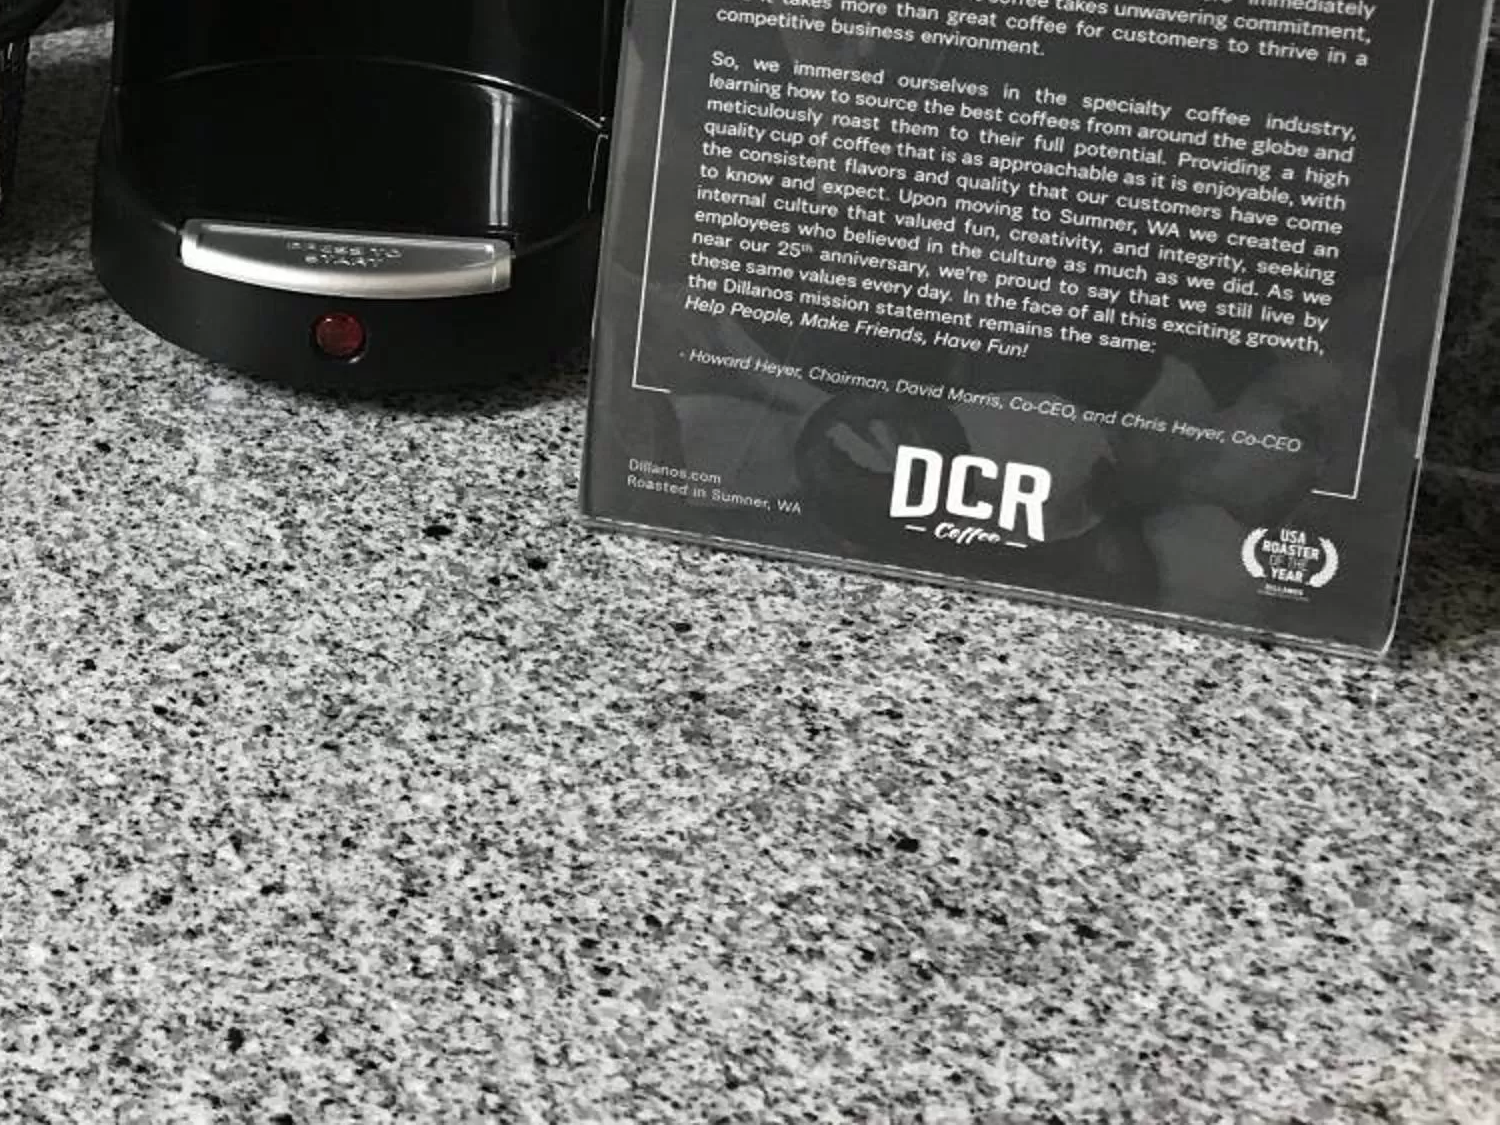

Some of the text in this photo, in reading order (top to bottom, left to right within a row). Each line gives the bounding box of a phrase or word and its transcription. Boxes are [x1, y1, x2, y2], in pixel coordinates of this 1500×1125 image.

[715, 7, 1045, 56] competitive business environment.
[895, 1, 939, 21] than
[945, 9, 997, 28] great
[1004, 13, 1068, 35] coffee
[1074, 18, 1105, 38] for
[1110, 27, 1219, 51] customers
[1226, 36, 1250, 54] to
[1257, 39, 1319, 61] thrive
[1326, 45, 1347, 64] in
[1353, 52, 1369, 67] a
[1112, 3, 1229, 31] unwavering
[1232, 15, 1371, 45] commitment,
[710, 49, 1357, 142] So, we immersed ourselves in the specialty coffee industry,
[705, 98, 1351, 189] meticulously roast them to their full potential. Providing a high
[695, 183, 1337, 286] internal culture that valued fun, creativity, and integrity, seeking
[683, 293, 726, 316] Help
[798, 310, 850, 332] Make
[932, 329, 982, 352] Have
[985, 337, 1029, 358] Fun!
[686, 273, 1157, 354] the Dillanos mission statement remains the same:
[687, 347, 753, 370] Howard
[894, 377, 945, 399] David
[1081, 409, 1119, 425] and
[1119, 411, 1168, 433] Chris
[1229, 428, 1303, 453] Co-CEO
[627, 474, 803, 516] Roasted in Sumner, WA
[628, 458, 722, 485] Dillanos.com
[889, 444, 1052, 543] DCR
[933, 521, 1002, 545] Coffee
[1261, 539, 1320, 561] ROASTER
[1280, 528, 1306, 545] USA
[1271, 566, 1304, 583] YEAR
